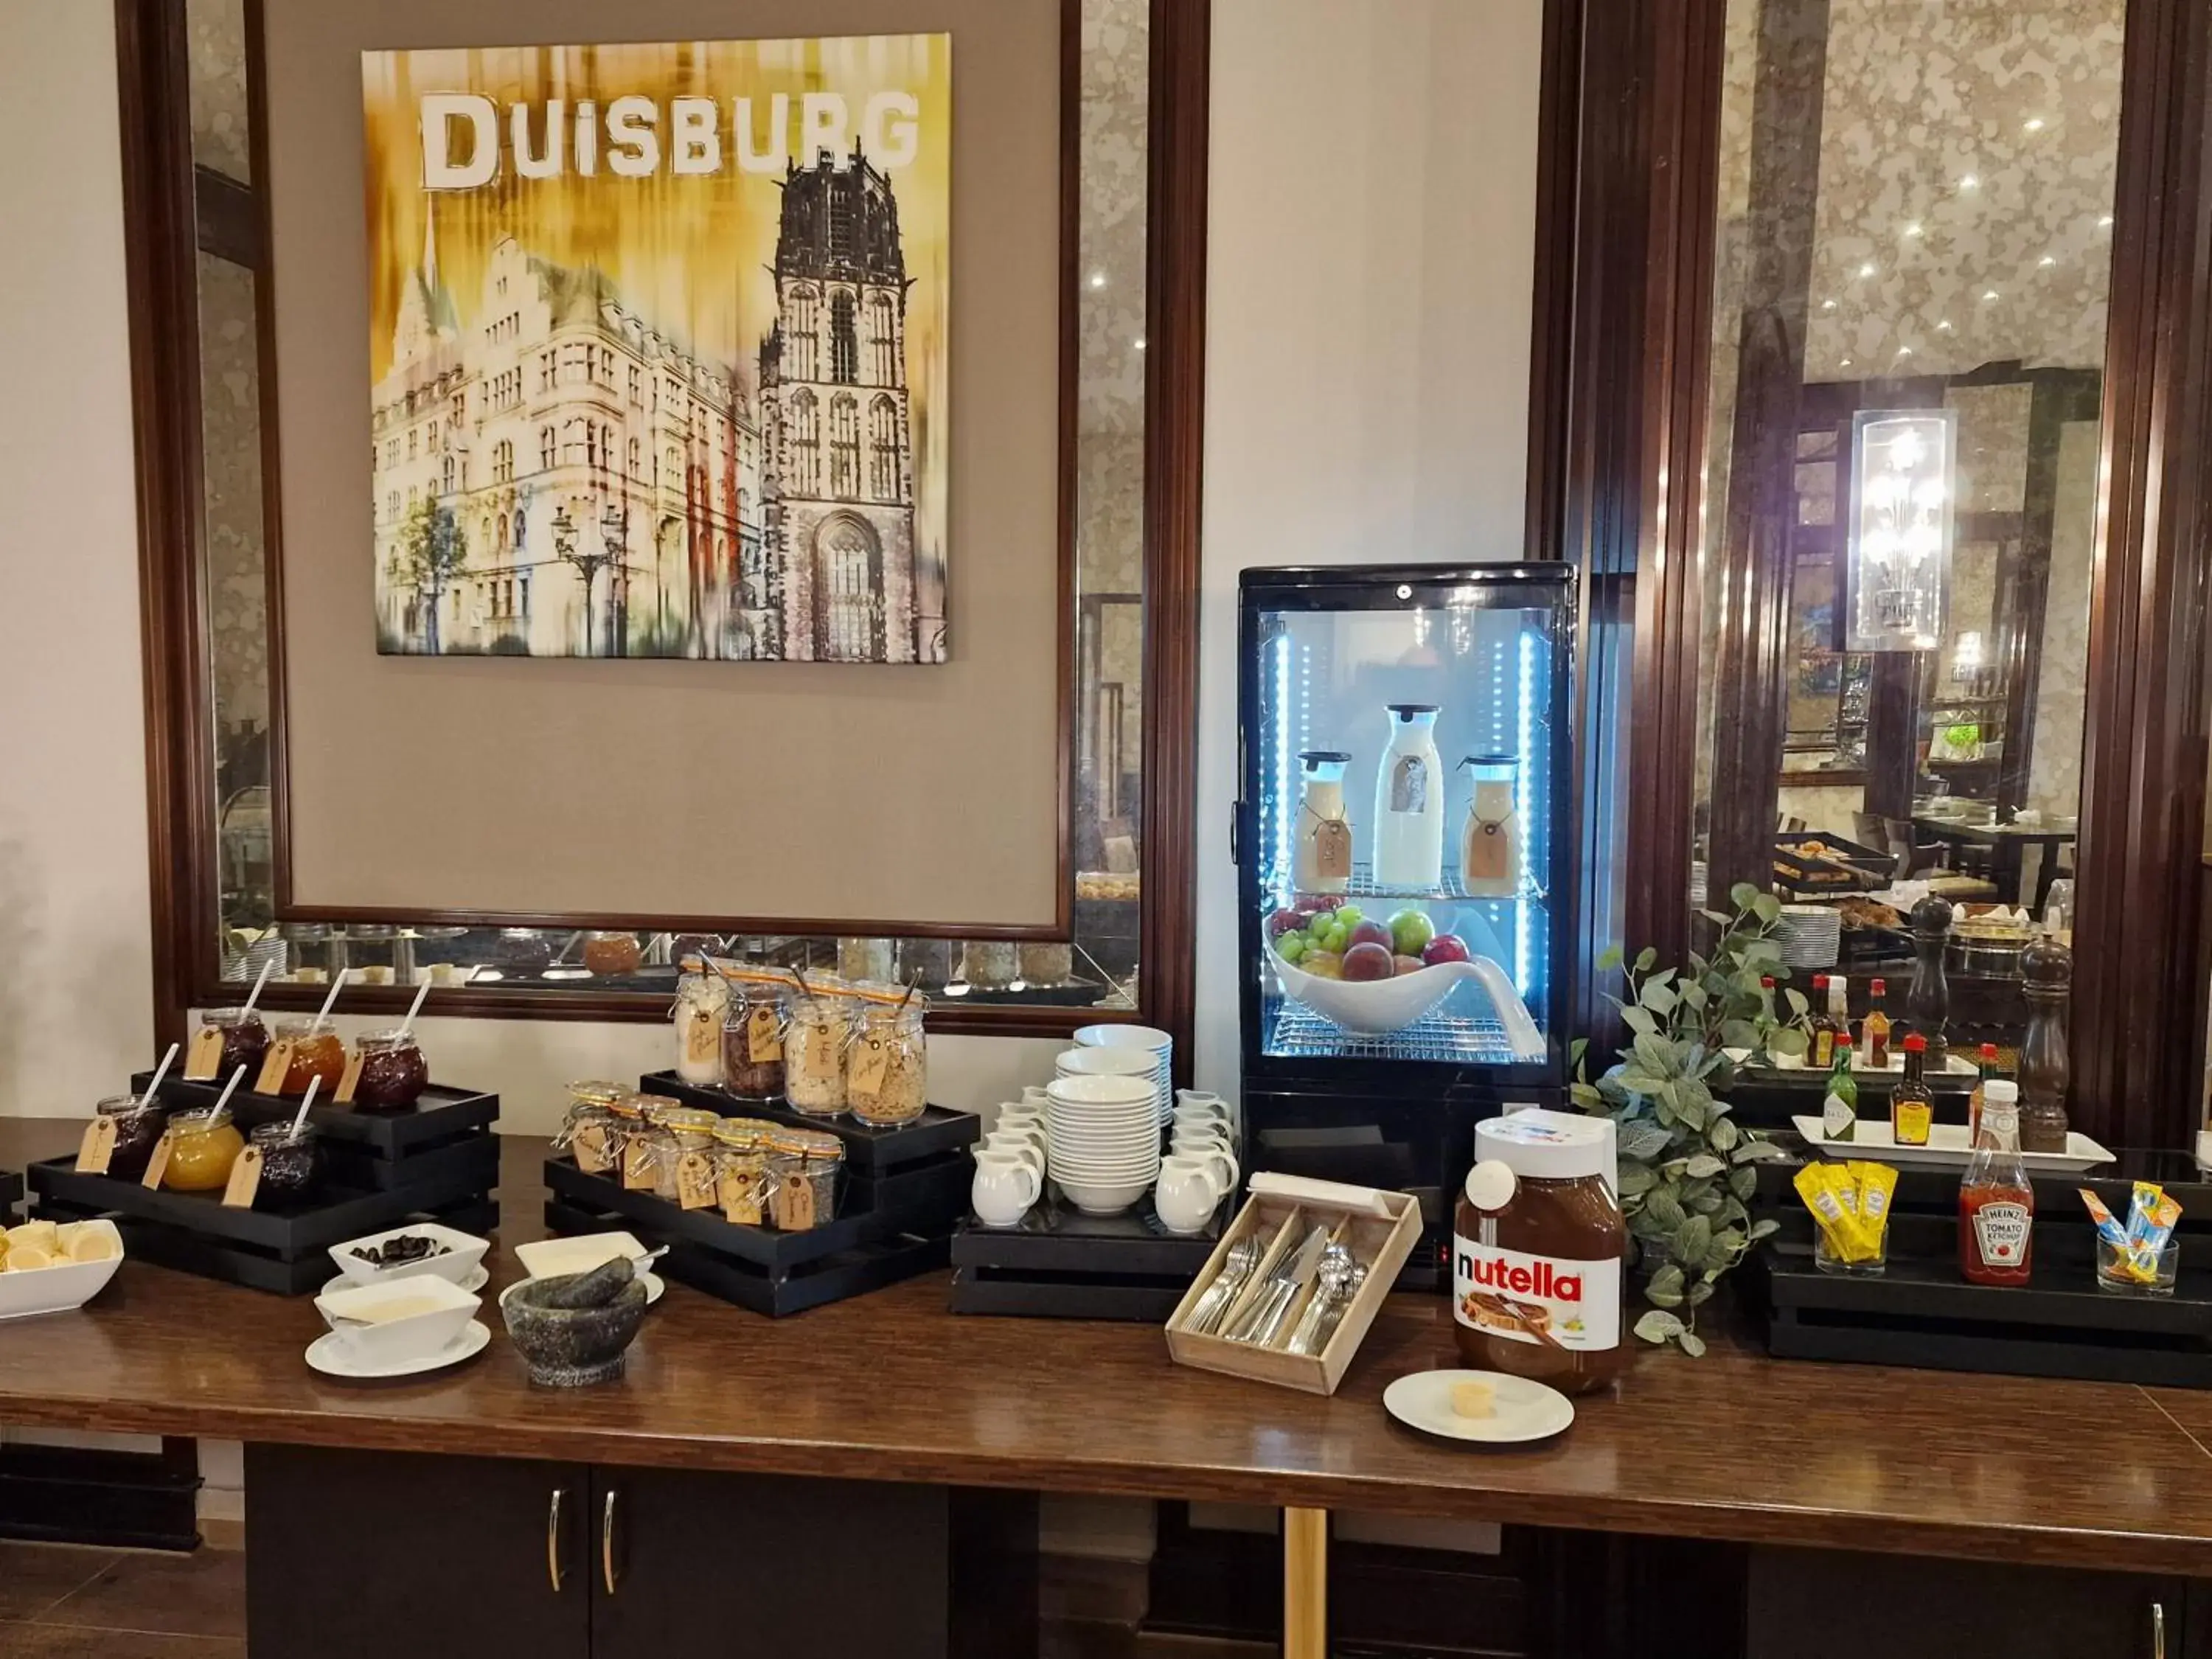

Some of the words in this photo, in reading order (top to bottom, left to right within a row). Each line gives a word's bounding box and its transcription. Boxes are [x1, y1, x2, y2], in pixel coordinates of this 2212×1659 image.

[1990, 1209, 2020, 1220] HEINZ
[1986, 1224, 2023, 1232] TOMATO
[1459, 1253, 1582, 1301] nutella
